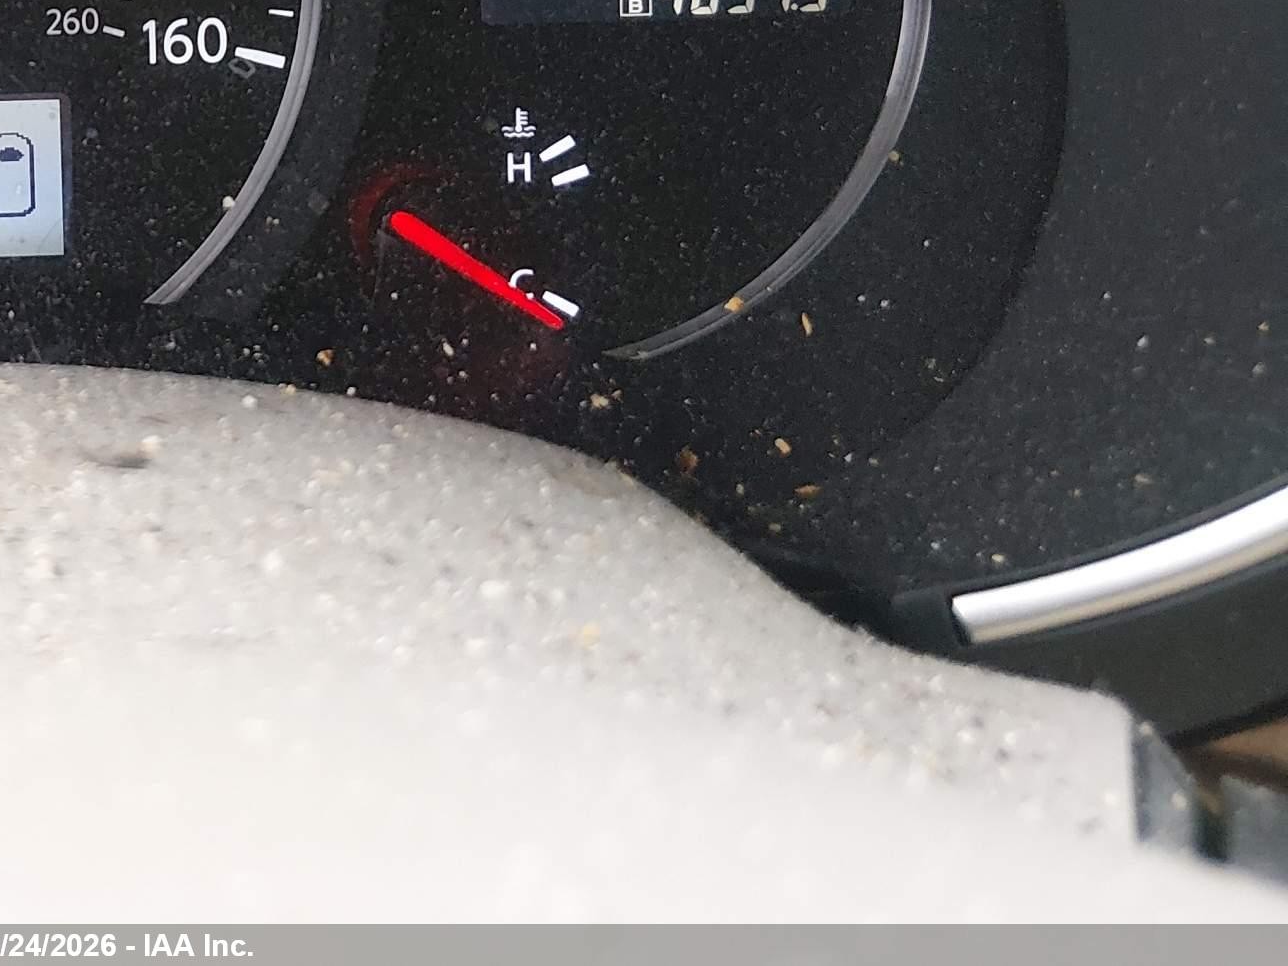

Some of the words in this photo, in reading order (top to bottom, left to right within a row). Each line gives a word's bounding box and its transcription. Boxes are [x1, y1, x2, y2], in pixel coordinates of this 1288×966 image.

[46, 8, 99, 35] 260
[142, 17, 228, 65] 160
[507, 151, 532, 183] H
